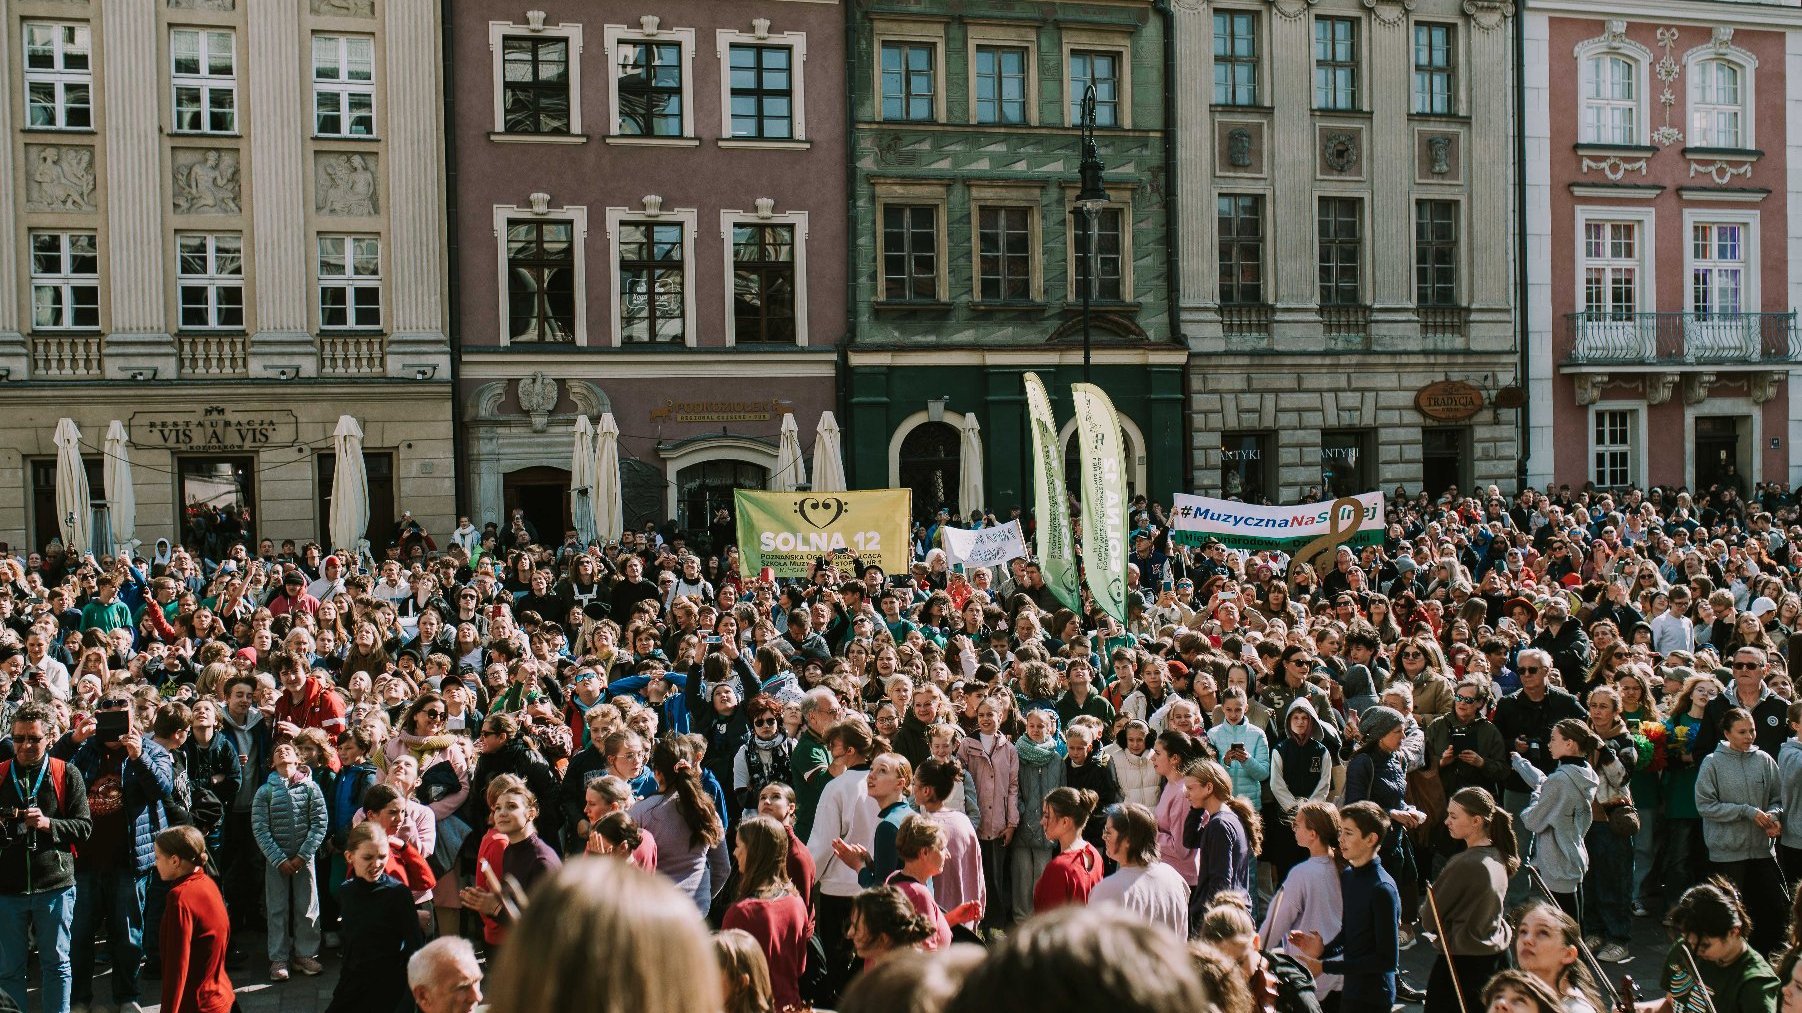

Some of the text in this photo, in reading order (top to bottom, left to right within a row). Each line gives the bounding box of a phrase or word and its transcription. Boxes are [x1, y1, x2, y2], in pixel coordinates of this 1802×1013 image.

[1427, 395, 1474, 407] TRADYCJA
[149, 419, 276, 429] RESTAURACJA
[158, 428, 193, 444] VIS
[235, 428, 269, 443] VIS
[760, 531, 881, 552] SOLNA 12
[1185, 532, 1281, 547] Międynarodowy
[1273, 695, 1284, 709] 5
